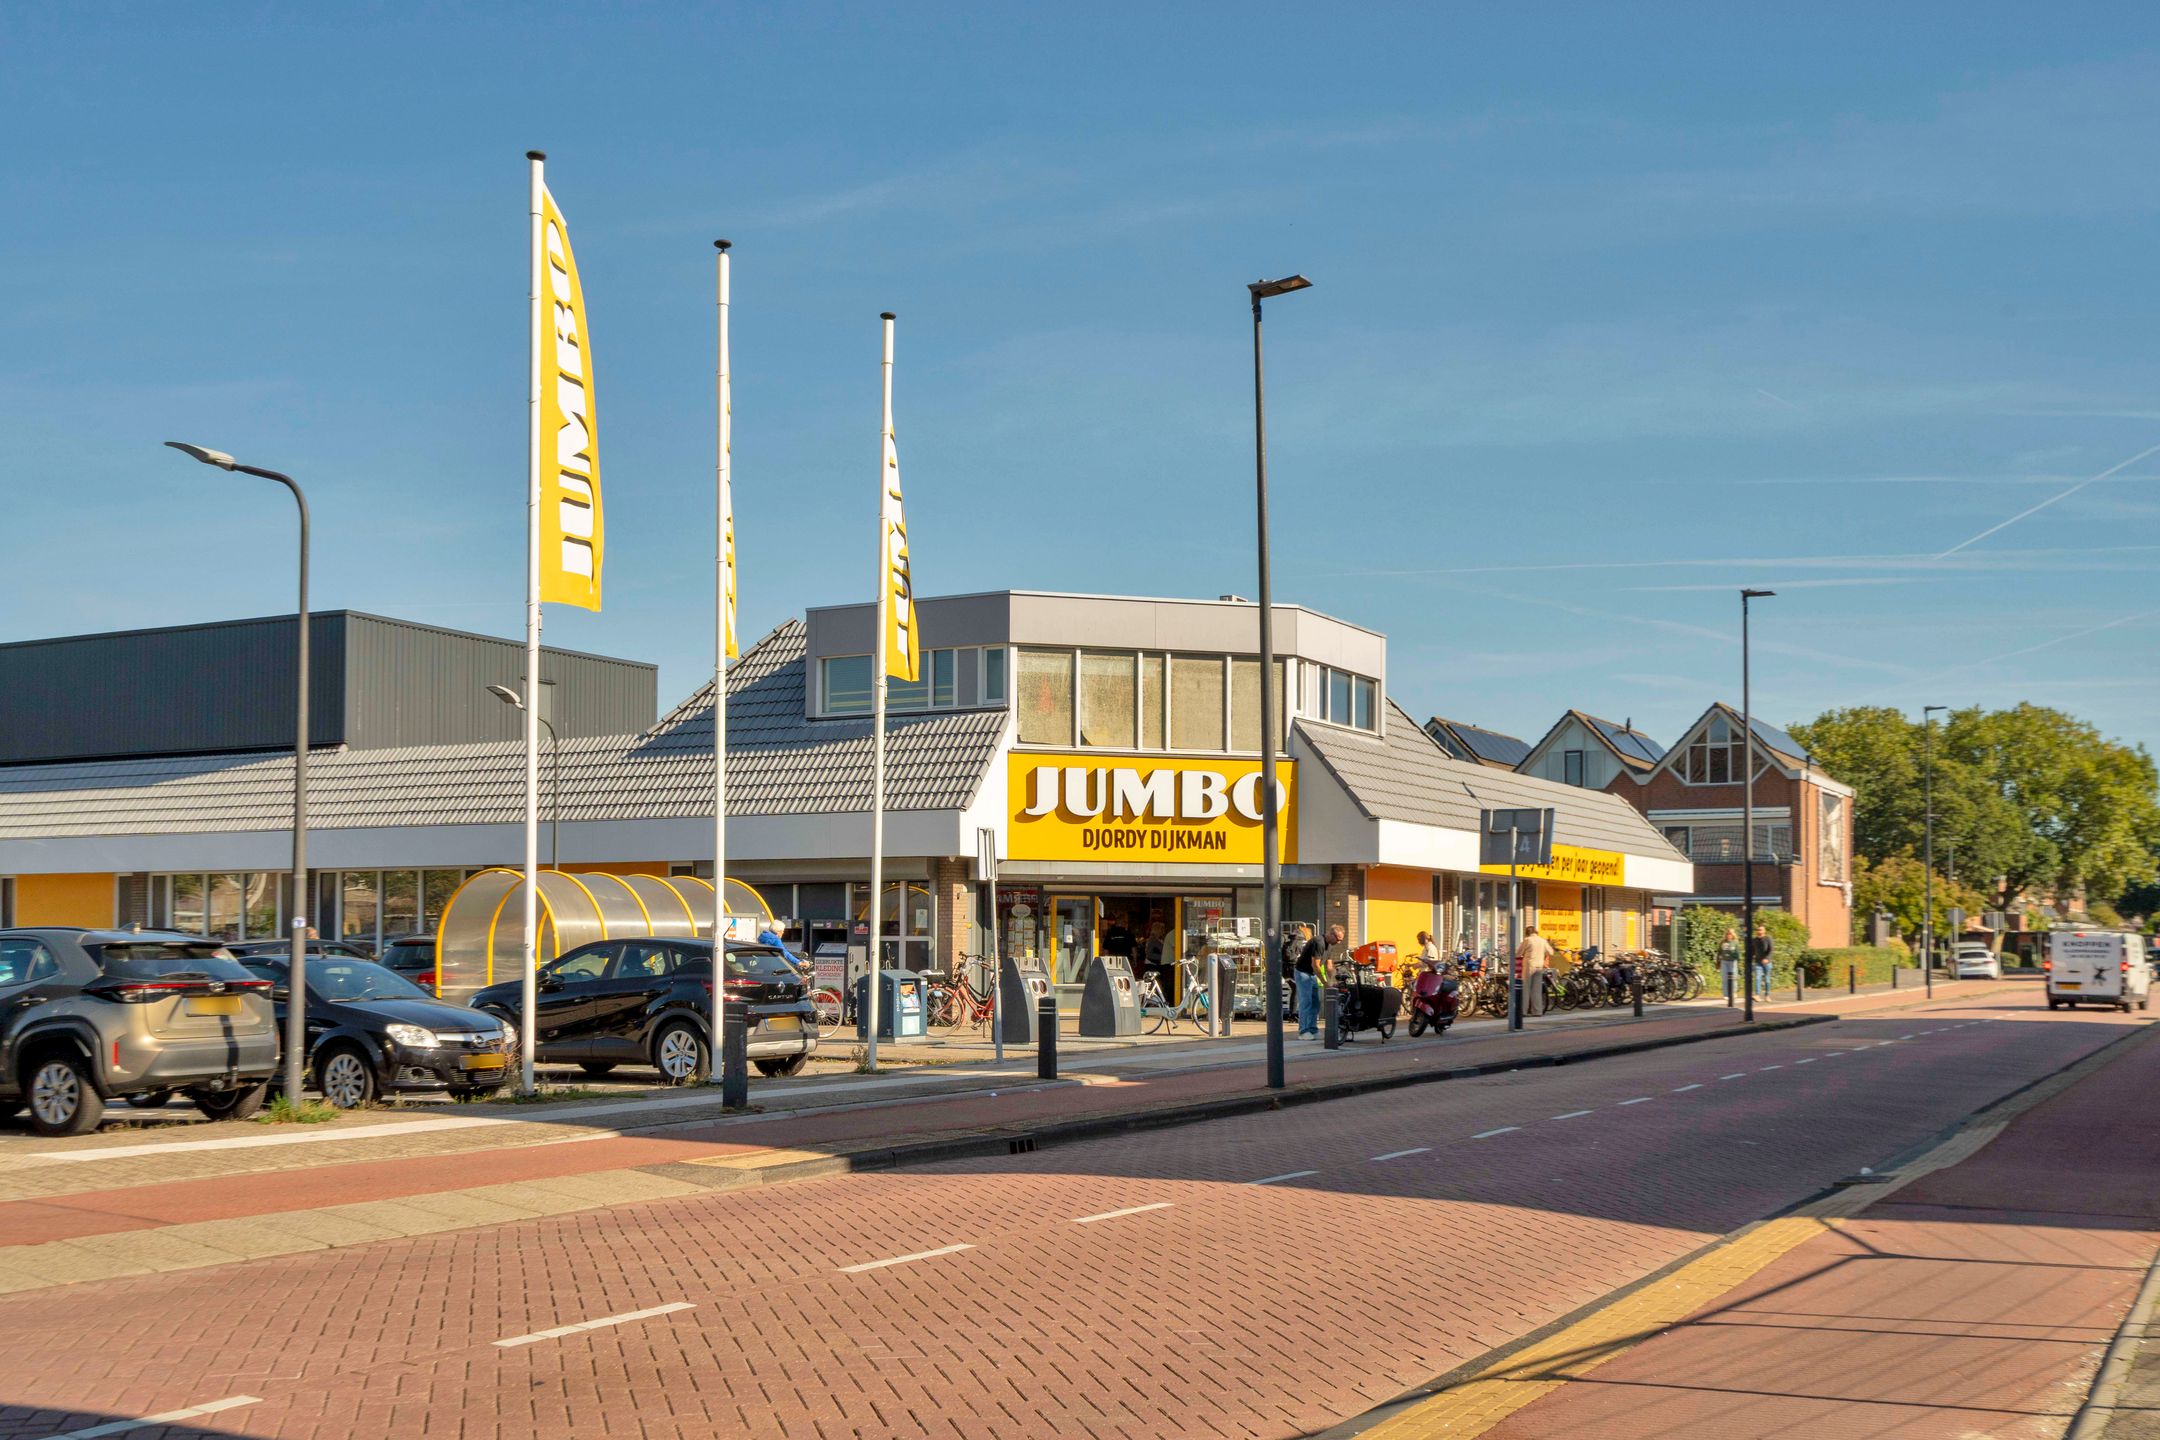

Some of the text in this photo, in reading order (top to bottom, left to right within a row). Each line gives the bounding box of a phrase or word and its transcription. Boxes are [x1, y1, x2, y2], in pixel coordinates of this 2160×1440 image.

[546, 219, 594, 594] JUMBO
[1024, 766, 1287, 821] JUMBO
[1083, 828, 1227, 852] DJORDY DIJKMAN
[1561, 856, 1572, 877] per
